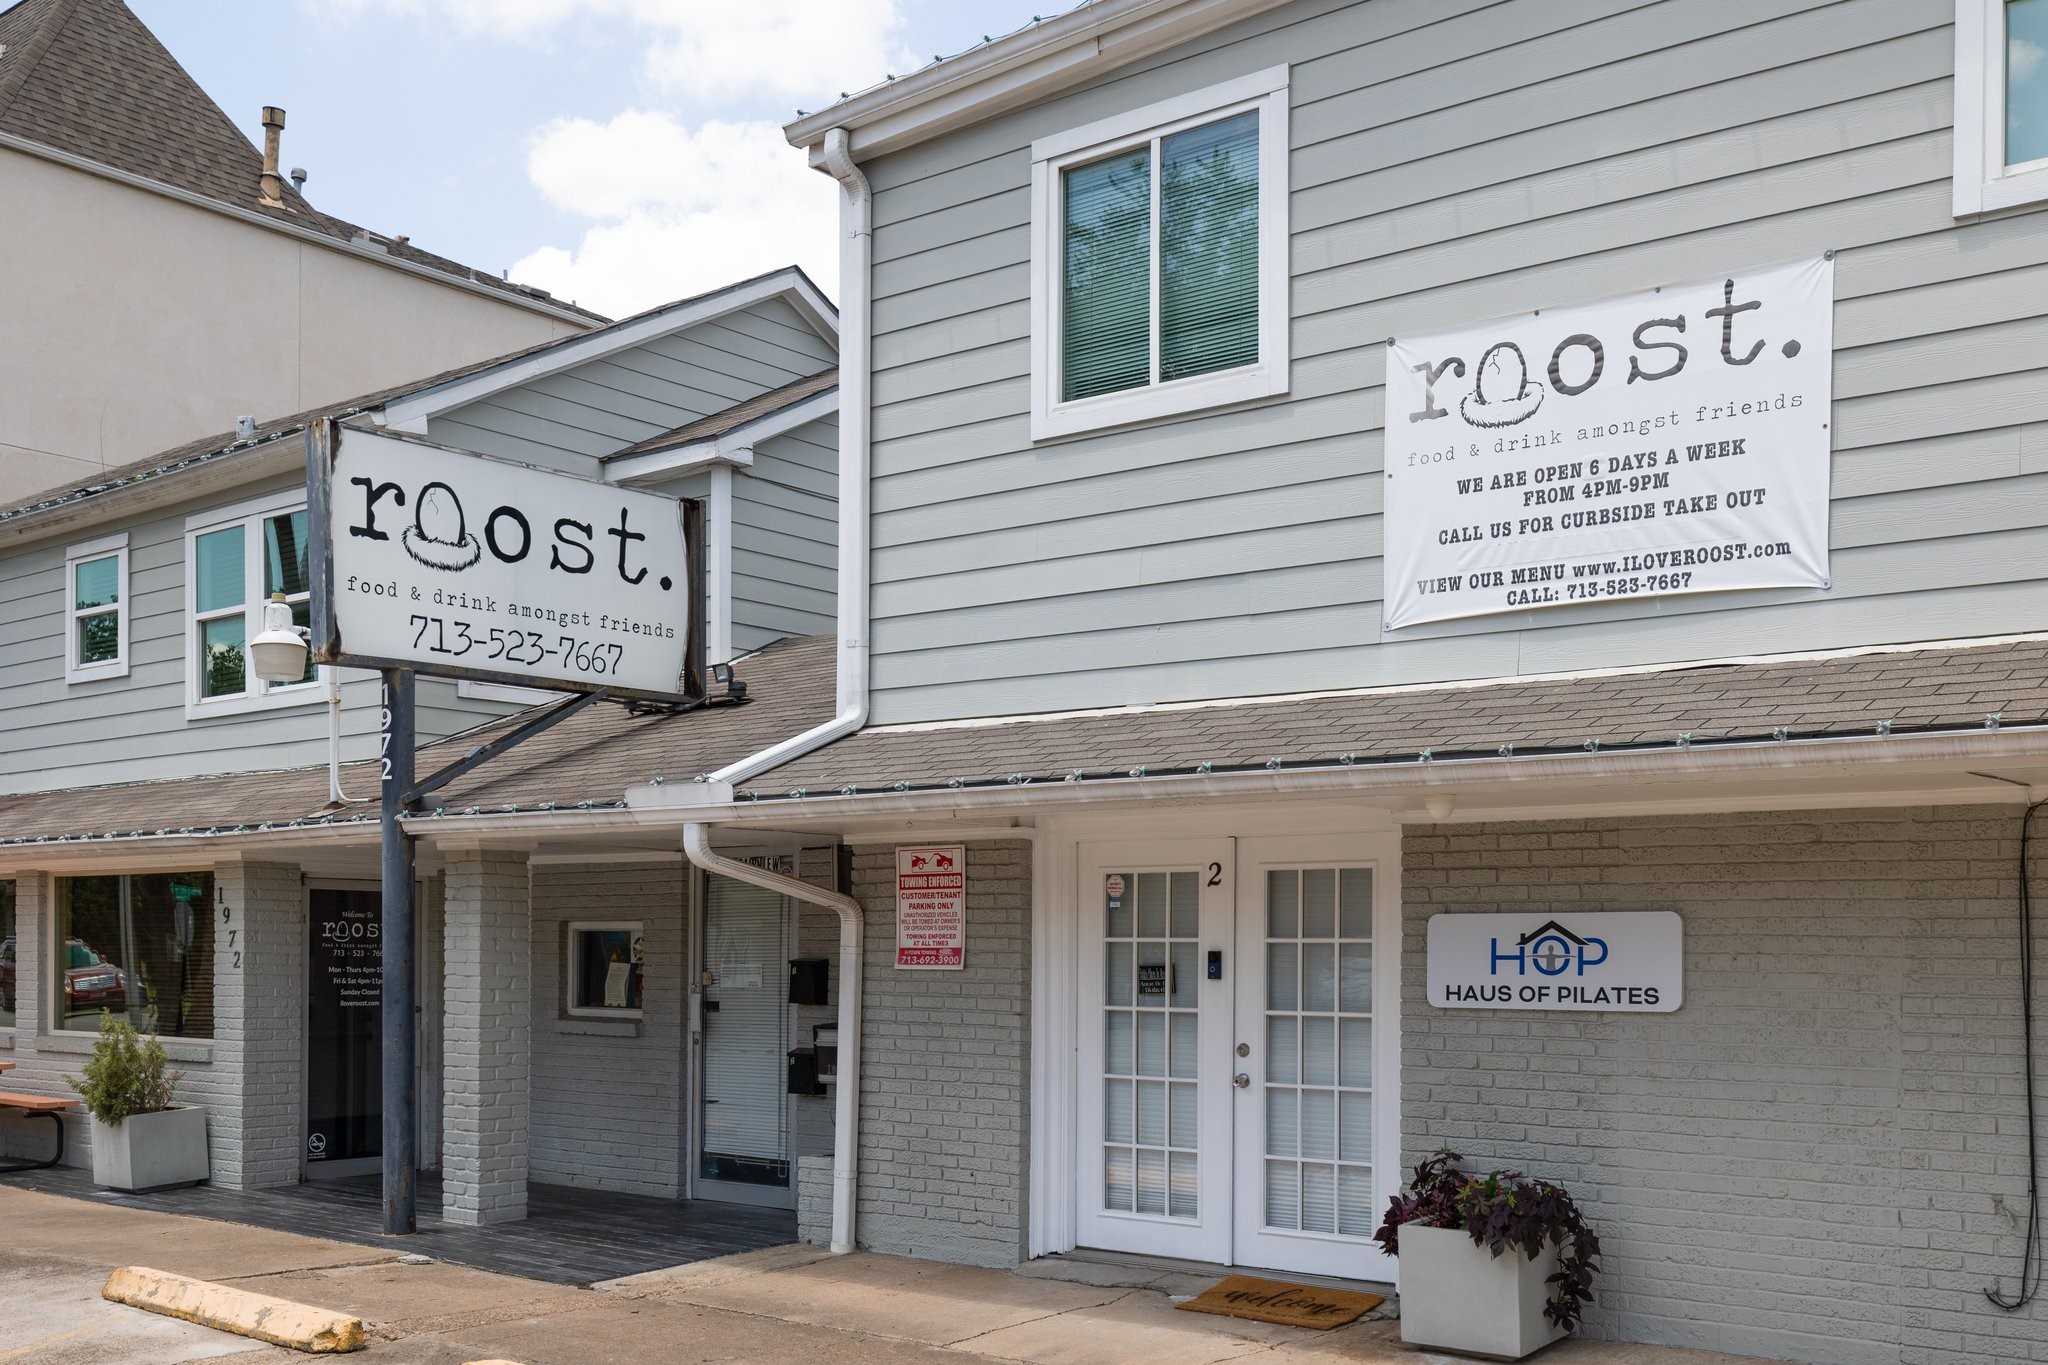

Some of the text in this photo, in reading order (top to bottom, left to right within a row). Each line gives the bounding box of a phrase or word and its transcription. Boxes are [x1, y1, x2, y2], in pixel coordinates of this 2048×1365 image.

[1409, 279, 1801, 428] roost.
[1407, 393, 1803, 467] food & drink amongst friends
[1457, 438, 1746, 495] WE ARE OPEN 6 DAYS A WEEK
[1523, 472, 1669, 507] FROM 4PM-9PM
[350, 477, 672, 590] roost.
[1438, 488, 1767, 546] CALL US FOR CURBSIDE TAKE OUT
[1417, 541, 1791, 595] VIEW OUR MENU www.ILOVEROOST.com
[1507, 572, 1692, 606] CALL: 713-523-7667
[347, 575, 674, 639] food & drink amongst friends
[410, 614, 623, 675] 713-523-7667
[901, 876, 961, 888] TOWING ENFORCED
[1207, 862, 1222, 887] 2
[322, 921, 384, 942] roos
[1491, 934, 1609, 976] HOP
[901, 956, 959, 964] 713-692-3900
[1445, 984, 1660, 1005] HAUS OF PILATES
